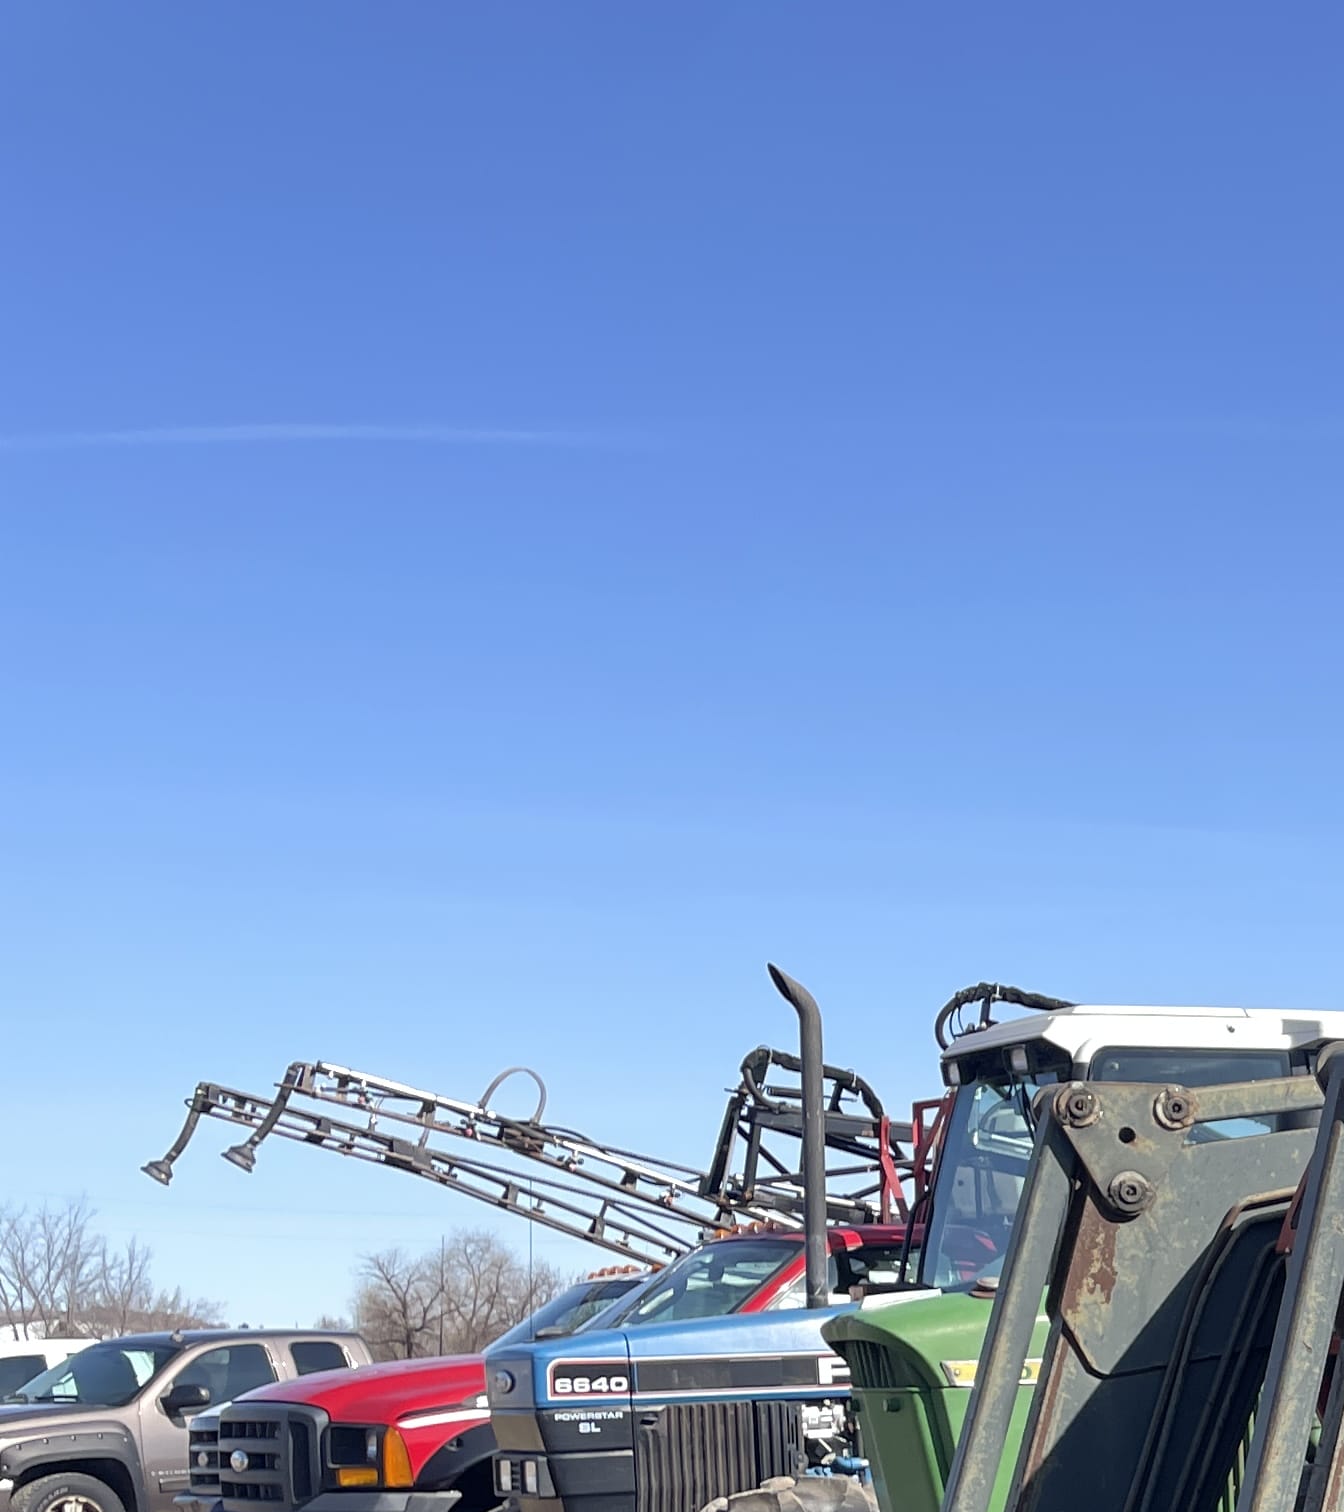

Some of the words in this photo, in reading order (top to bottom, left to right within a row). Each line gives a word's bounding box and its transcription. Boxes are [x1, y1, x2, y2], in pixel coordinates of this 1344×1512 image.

[554, 1376, 628, 1393] 6640
[553, 1410, 624, 1422] POWERSTAR
[578, 1421, 602, 1434] SL
